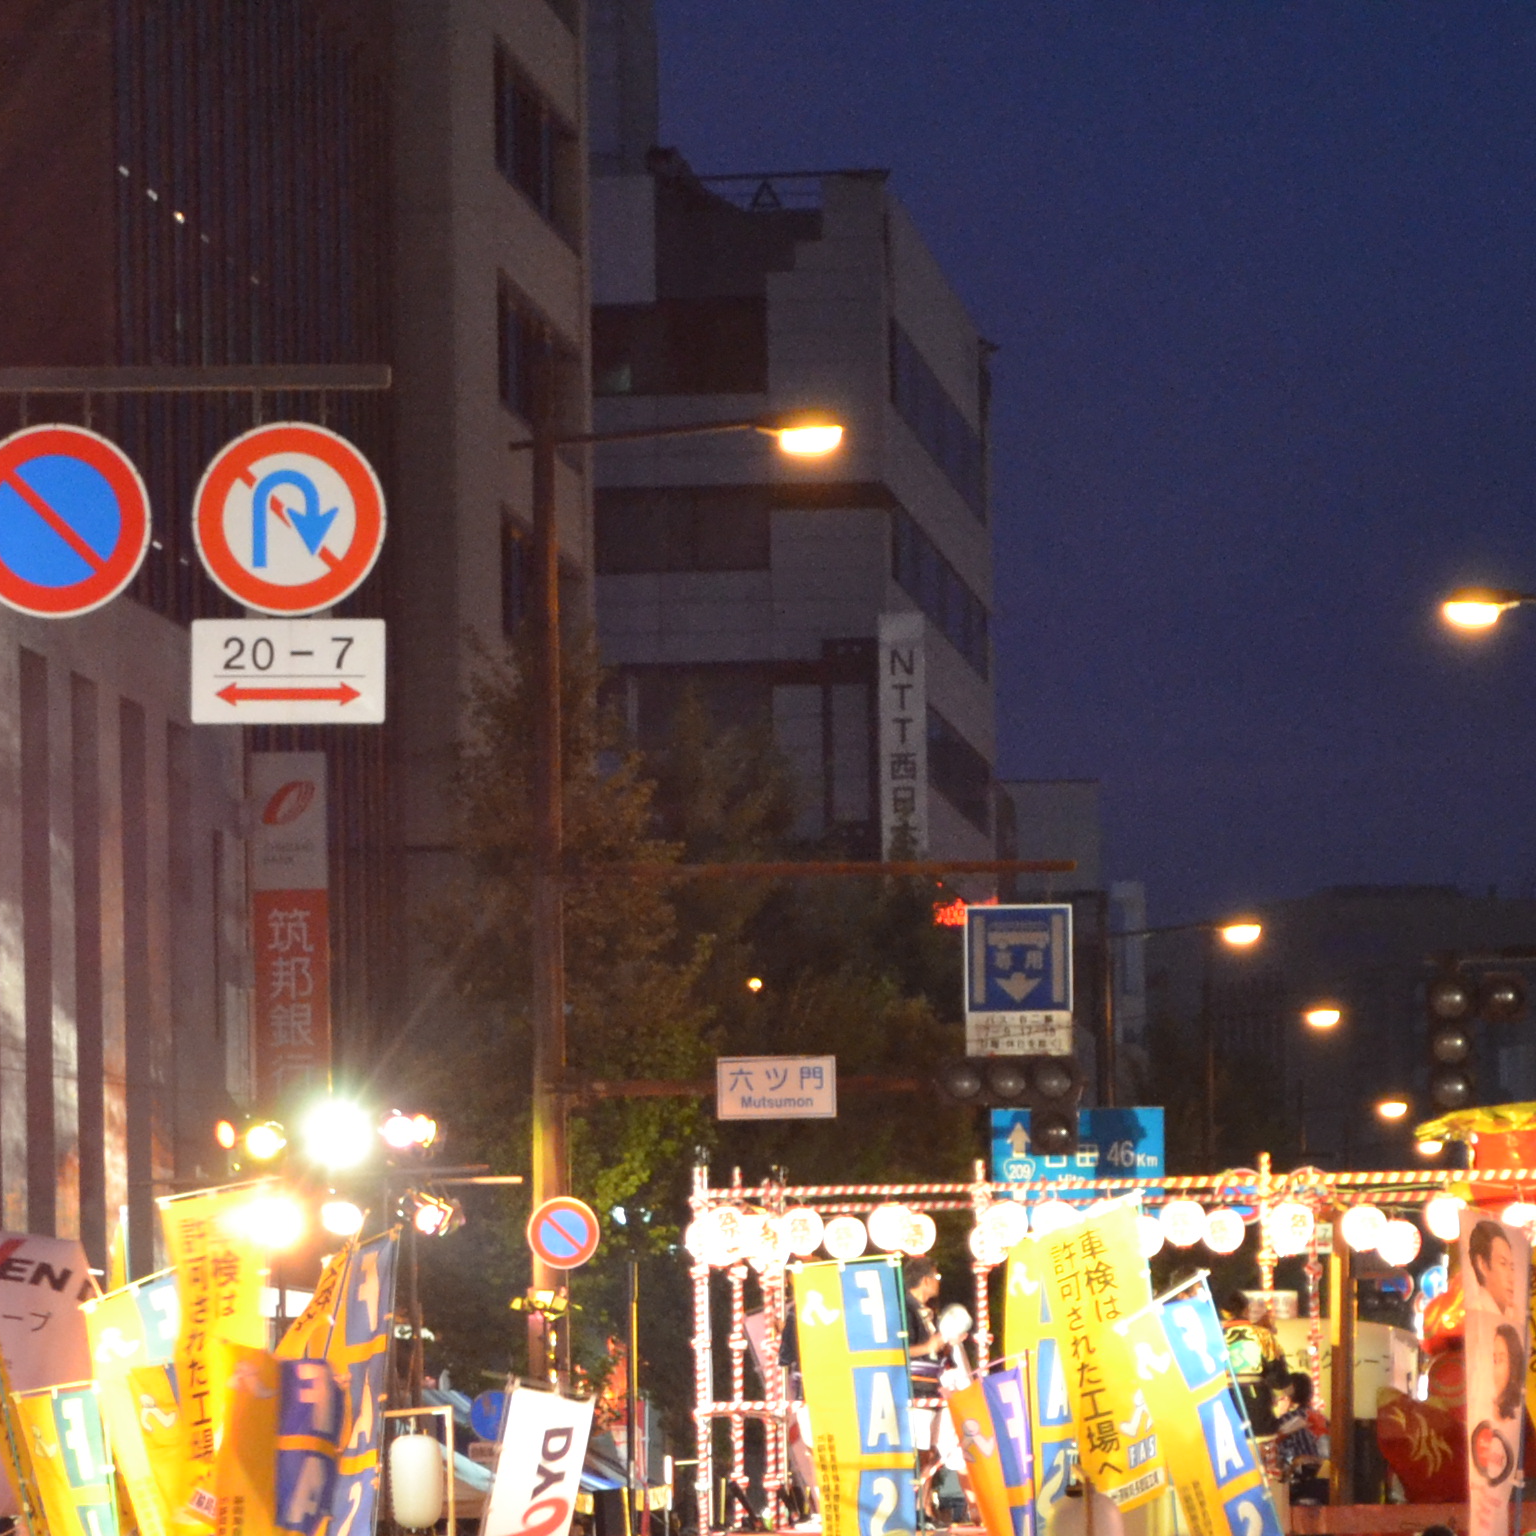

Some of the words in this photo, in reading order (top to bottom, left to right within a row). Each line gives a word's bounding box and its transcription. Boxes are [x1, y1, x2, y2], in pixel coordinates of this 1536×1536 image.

[729, 1066, 824, 1092] 六ツ門
[741, 1096, 814, 1109] Mutsumon
[1008, 1163, 1031, 1180] 209
[1079, 1230, 1123, 1321] 車検は
[1051, 1242, 1124, 1475] 許可された工場へ
